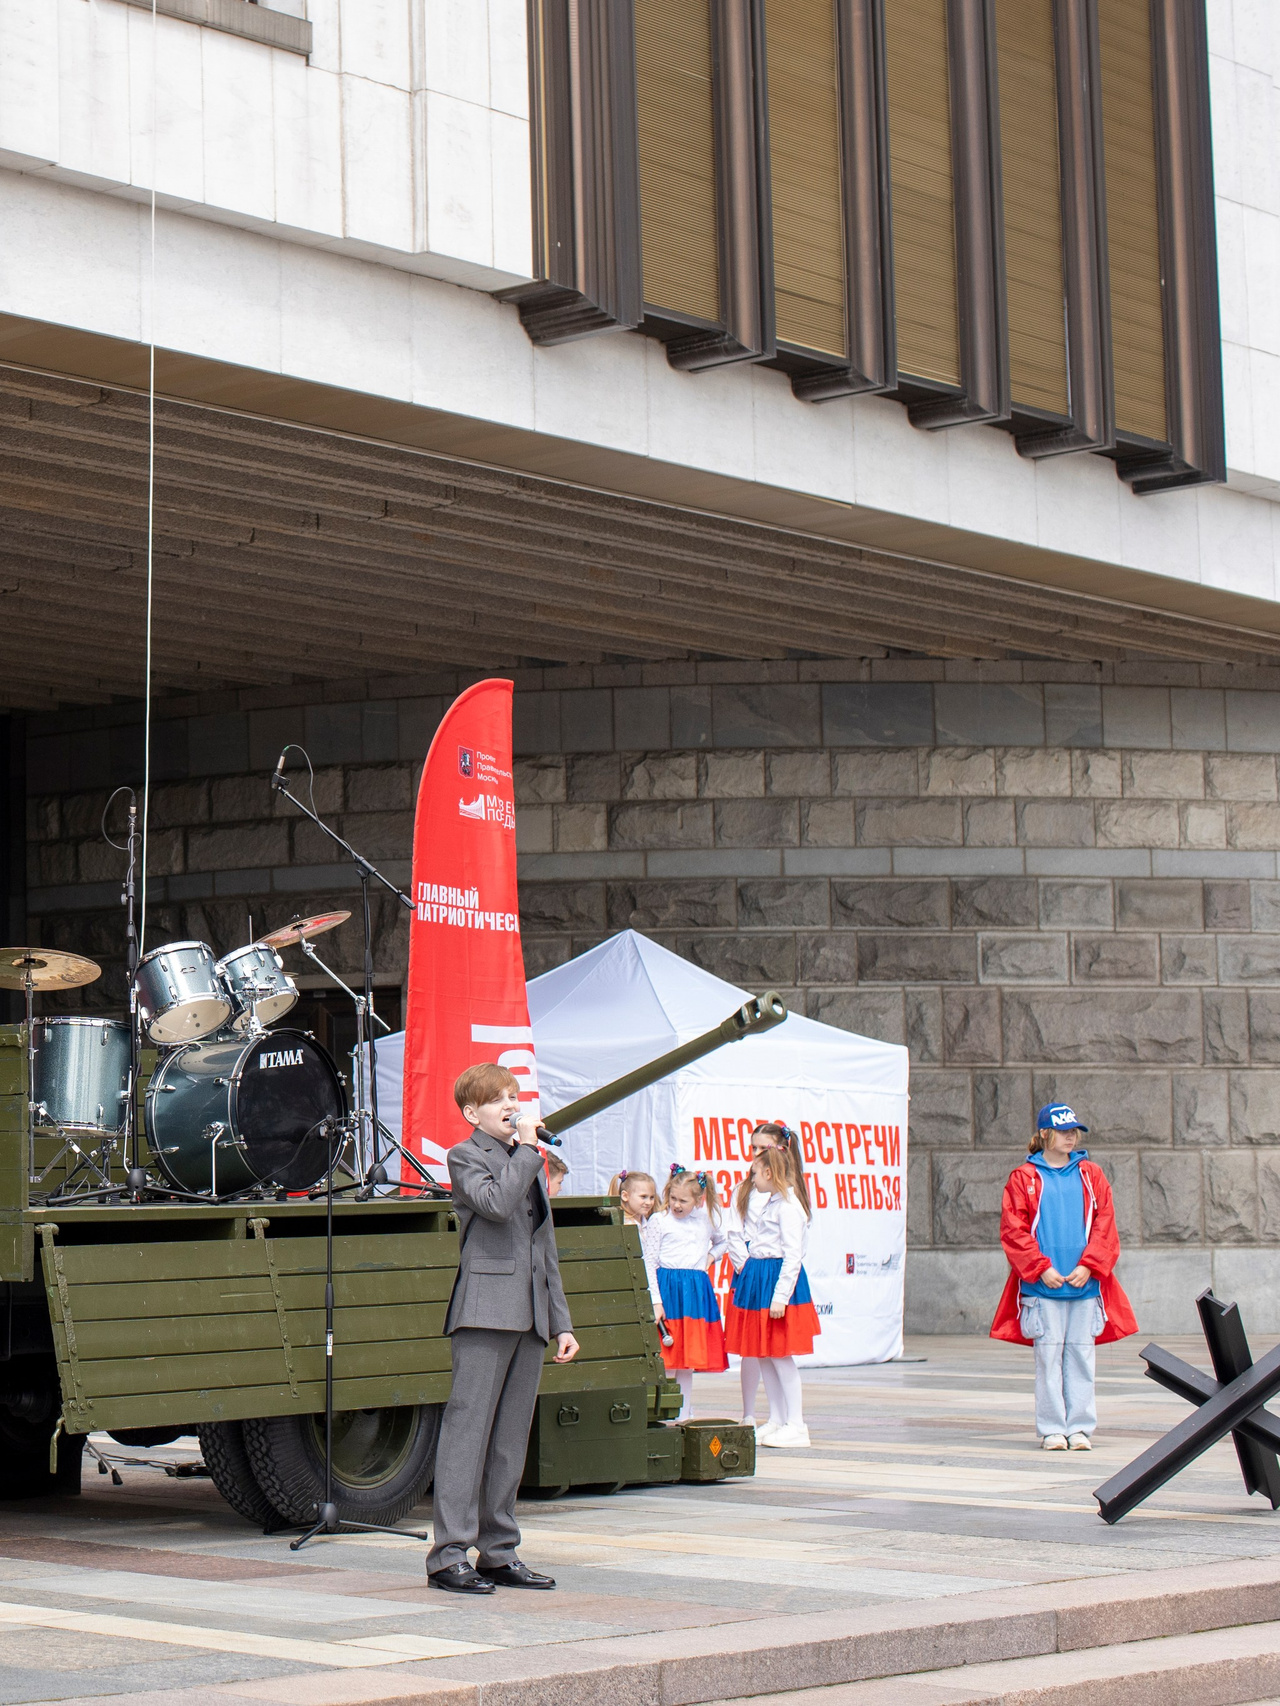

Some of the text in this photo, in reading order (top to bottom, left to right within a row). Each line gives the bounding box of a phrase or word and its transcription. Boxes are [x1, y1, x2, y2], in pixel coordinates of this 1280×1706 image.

[418, 881, 479, 910] ГЛАВНЫЙ
[267, 1049, 304, 1068] TAMA
[693, 1117, 900, 1167] МЕС ВСТРЕЧИ
[835, 1173, 901, 1211] НЕЛЬЗЯ
